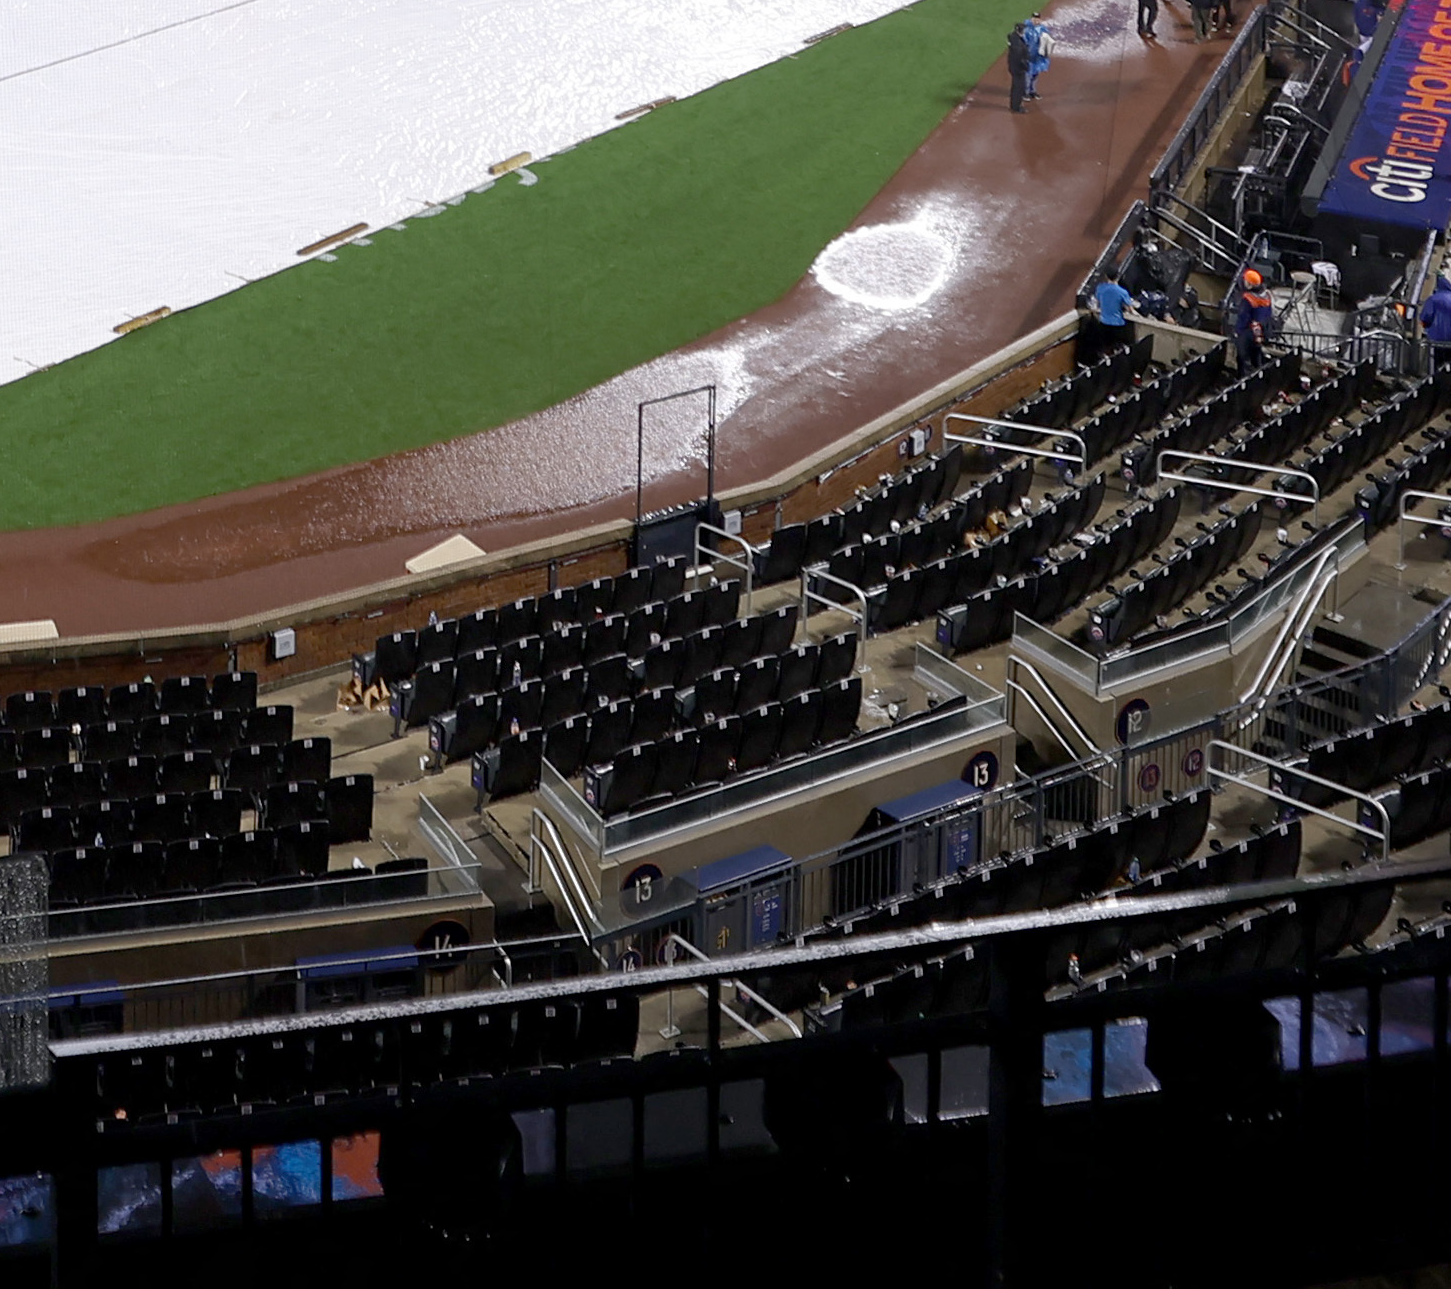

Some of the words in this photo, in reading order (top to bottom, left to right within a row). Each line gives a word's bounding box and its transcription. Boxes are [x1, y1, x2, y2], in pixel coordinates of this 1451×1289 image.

[1386, 114, 1449, 163] FIELD
[1366, 159, 1434, 203] citi
[973, 762, 989, 787] 13
[634, 877, 652, 904] 13
